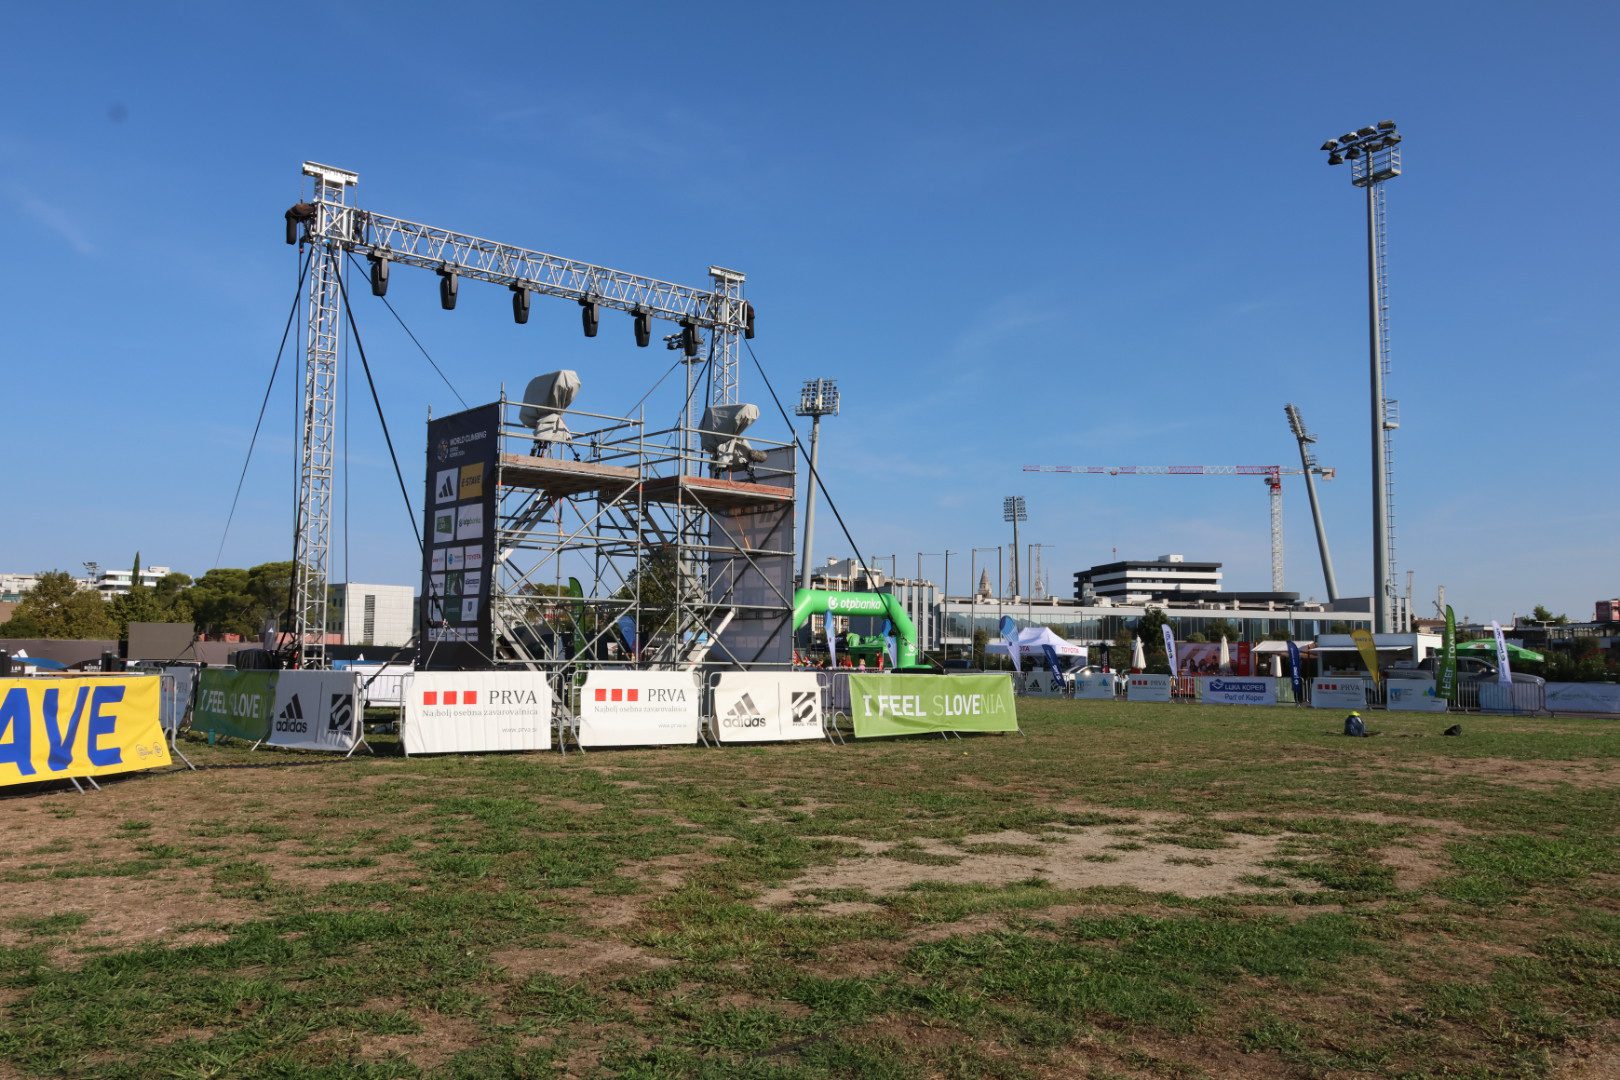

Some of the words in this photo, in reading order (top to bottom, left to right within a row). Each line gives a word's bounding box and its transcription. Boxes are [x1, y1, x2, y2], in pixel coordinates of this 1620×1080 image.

[205, 690, 228, 714] FEEL
[489, 690, 538, 705] PRVA
[647, 688, 686, 702] PRVA
[1246, 694, 1264, 702] Koper
[862, 695, 873, 717] I
[878, 695, 927, 717] FEEL
[932, 694, 1006, 716] SLOVENIA
[276, 720, 307, 733] adidas
[722, 715, 767, 727] adidas
